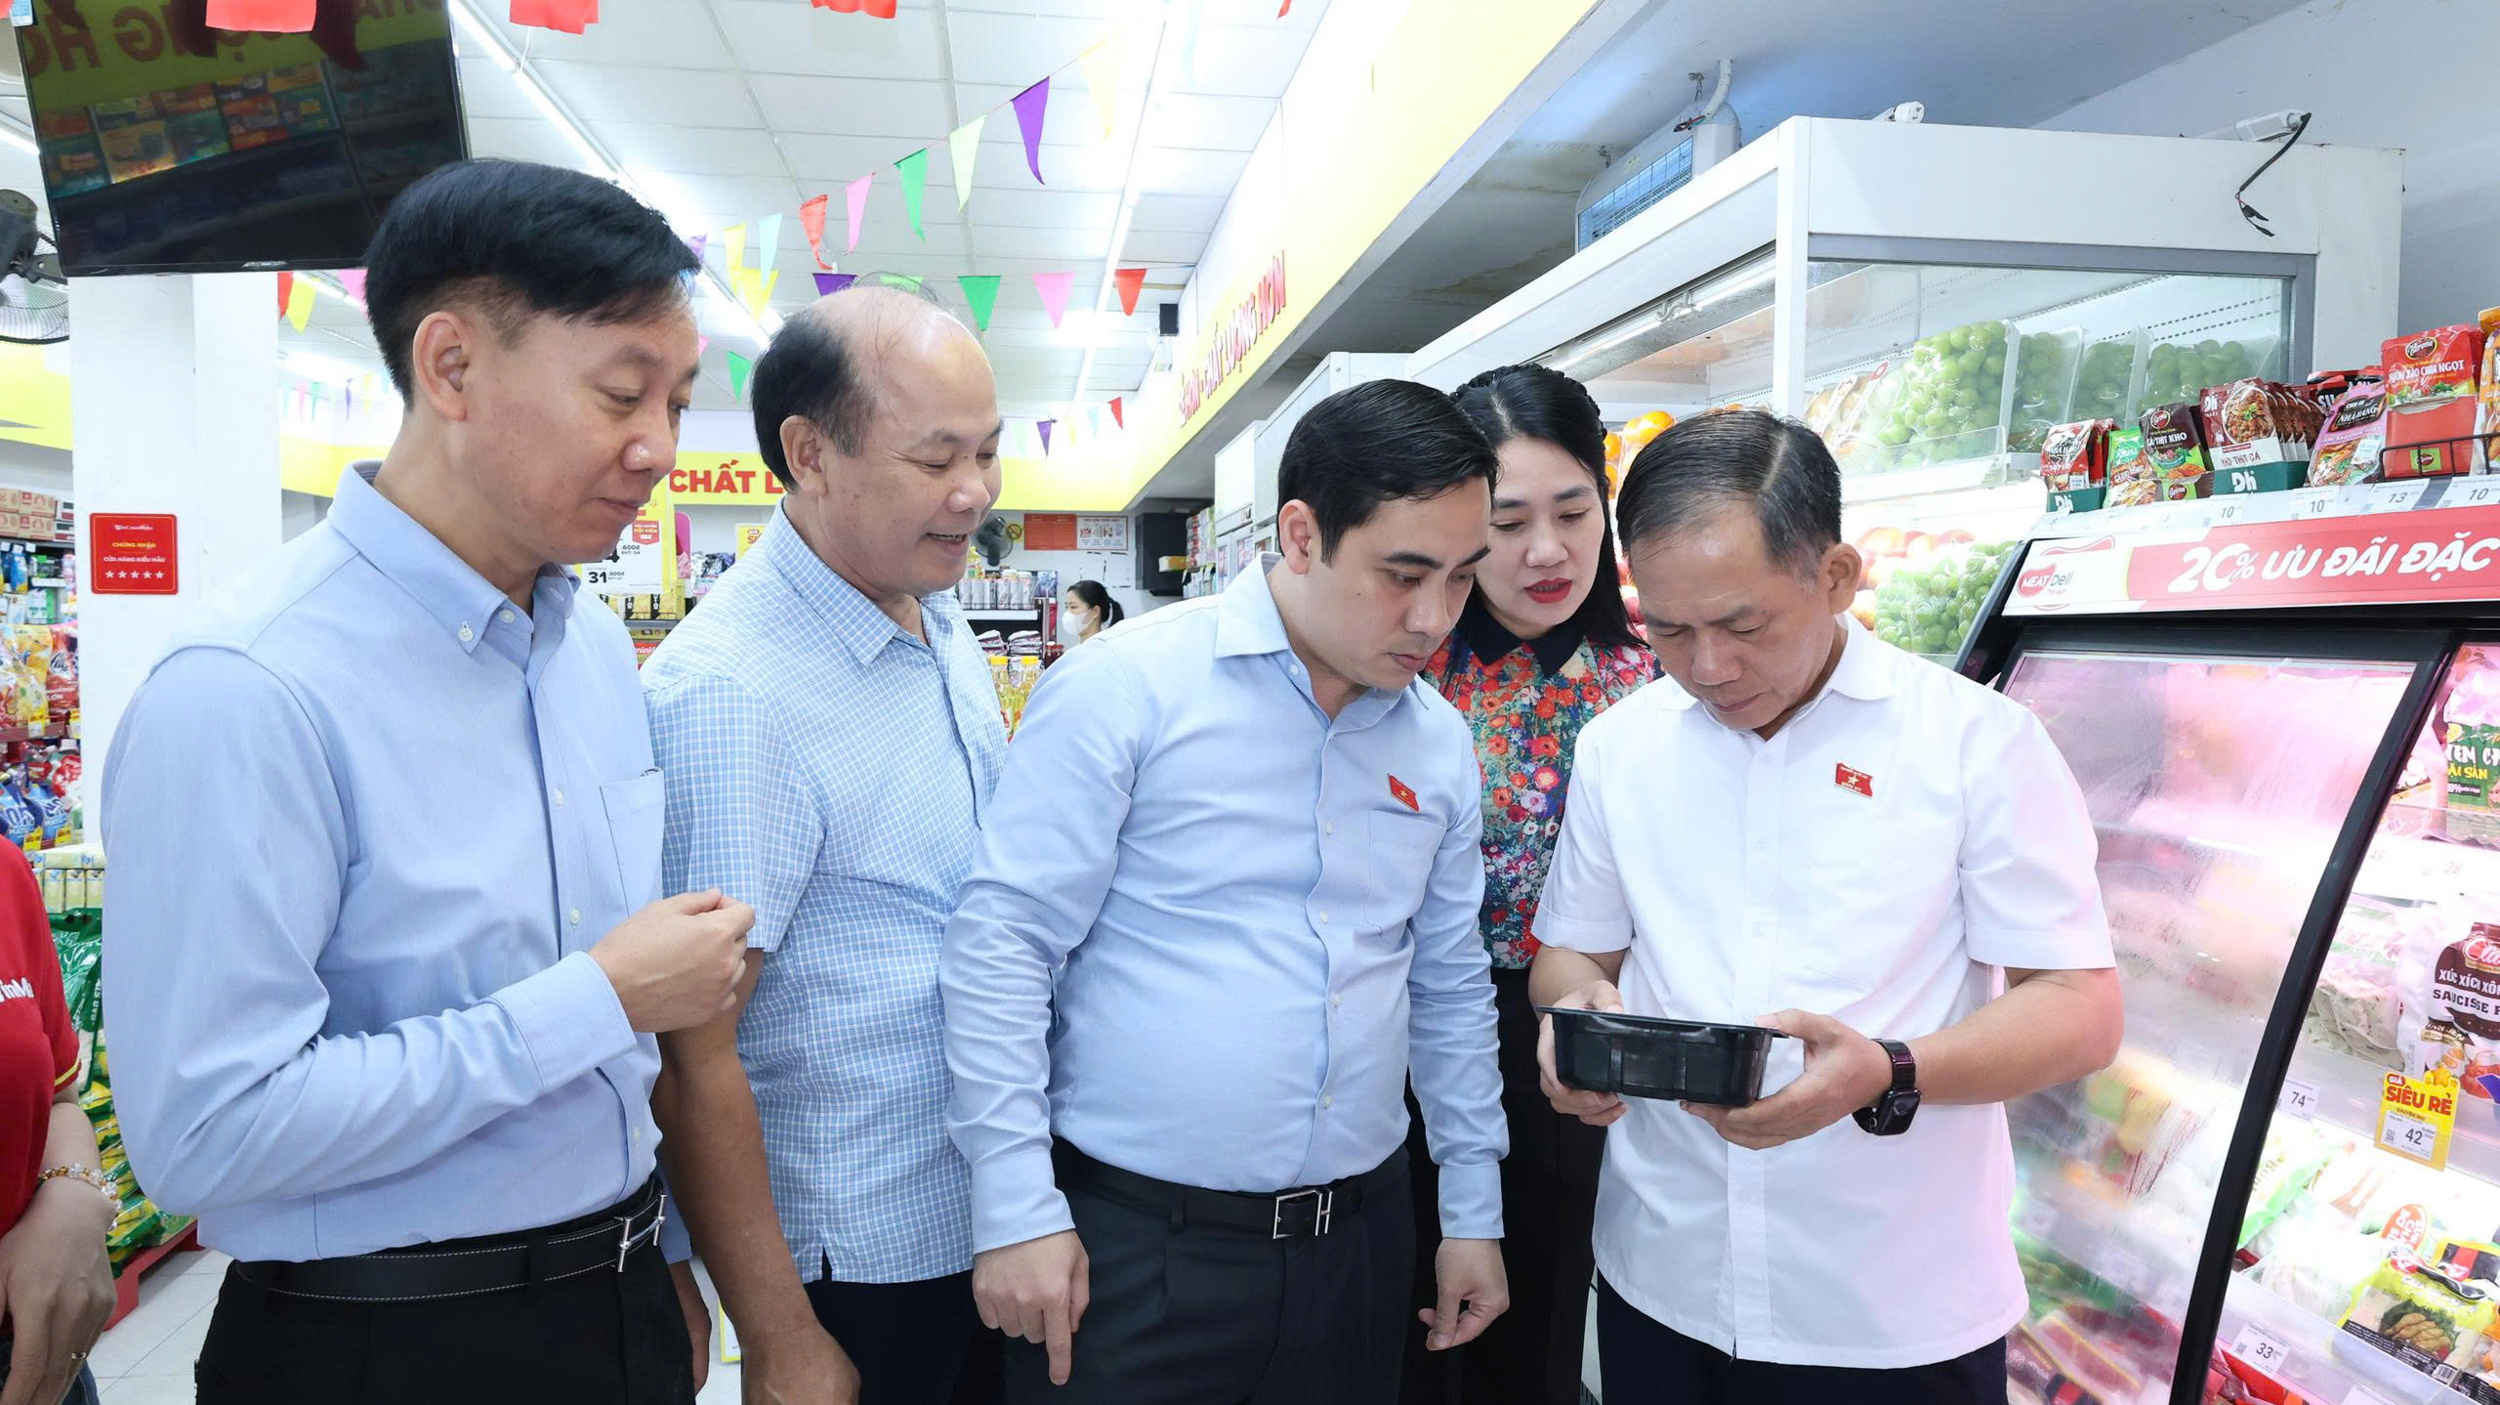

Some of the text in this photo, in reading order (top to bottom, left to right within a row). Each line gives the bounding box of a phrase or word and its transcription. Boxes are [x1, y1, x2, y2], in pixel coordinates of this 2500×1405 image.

[1258, 250, 1287, 336] HƠN
[2438, 360, 2465, 373] NGỌT
[2168, 432, 2187, 443] KHO
[669, 459, 756, 493] CHẤT
[2388, 492, 2408, 503] 13
[2468, 488, 2490, 501] 10
[2219, 506, 2235, 518] 10
[2310, 499, 2325, 513] 10
[2261, 544, 2323, 580] ƯU
[2321, 535, 2399, 577] ĐÃI
[2398, 531, 2500, 581] ĐẶC
[588, 571, 607, 584] 31
[2291, 1091, 2306, 1107] 74
[2386, 1085, 2453, 1116] SIÊU RẺ
[2405, 1128, 2423, 1145] 42
[2256, 1342, 2274, 1359] 33
